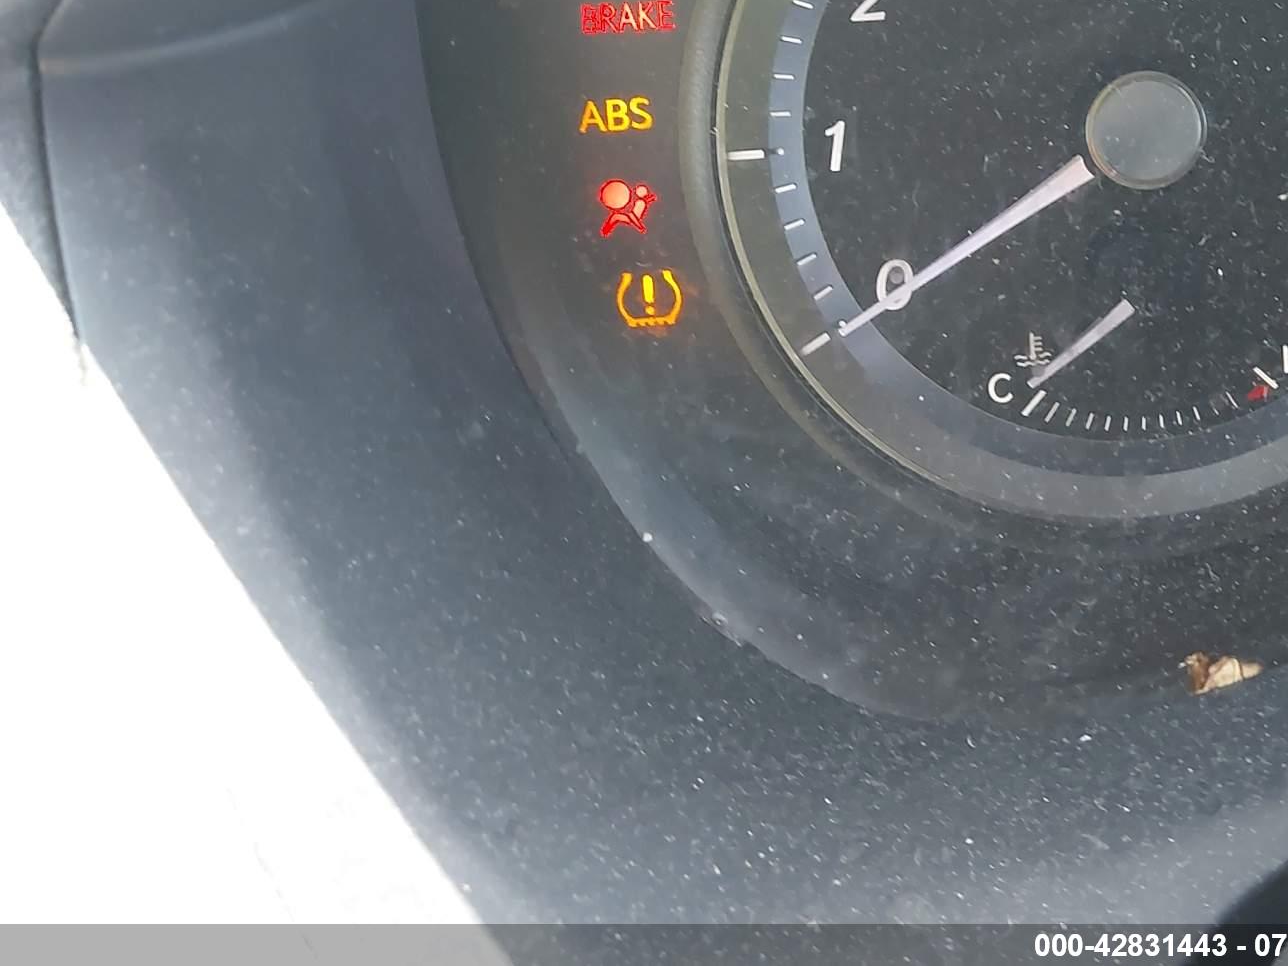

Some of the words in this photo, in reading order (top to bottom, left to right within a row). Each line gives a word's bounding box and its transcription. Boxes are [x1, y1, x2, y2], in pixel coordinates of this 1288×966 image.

[579, 0, 676, 34] BRAKE
[579, 97, 655, 134] ABS
[823, 120, 846, 172] 1
[876, 258, 913, 310] 0
[987, 372, 1014, 404] C
